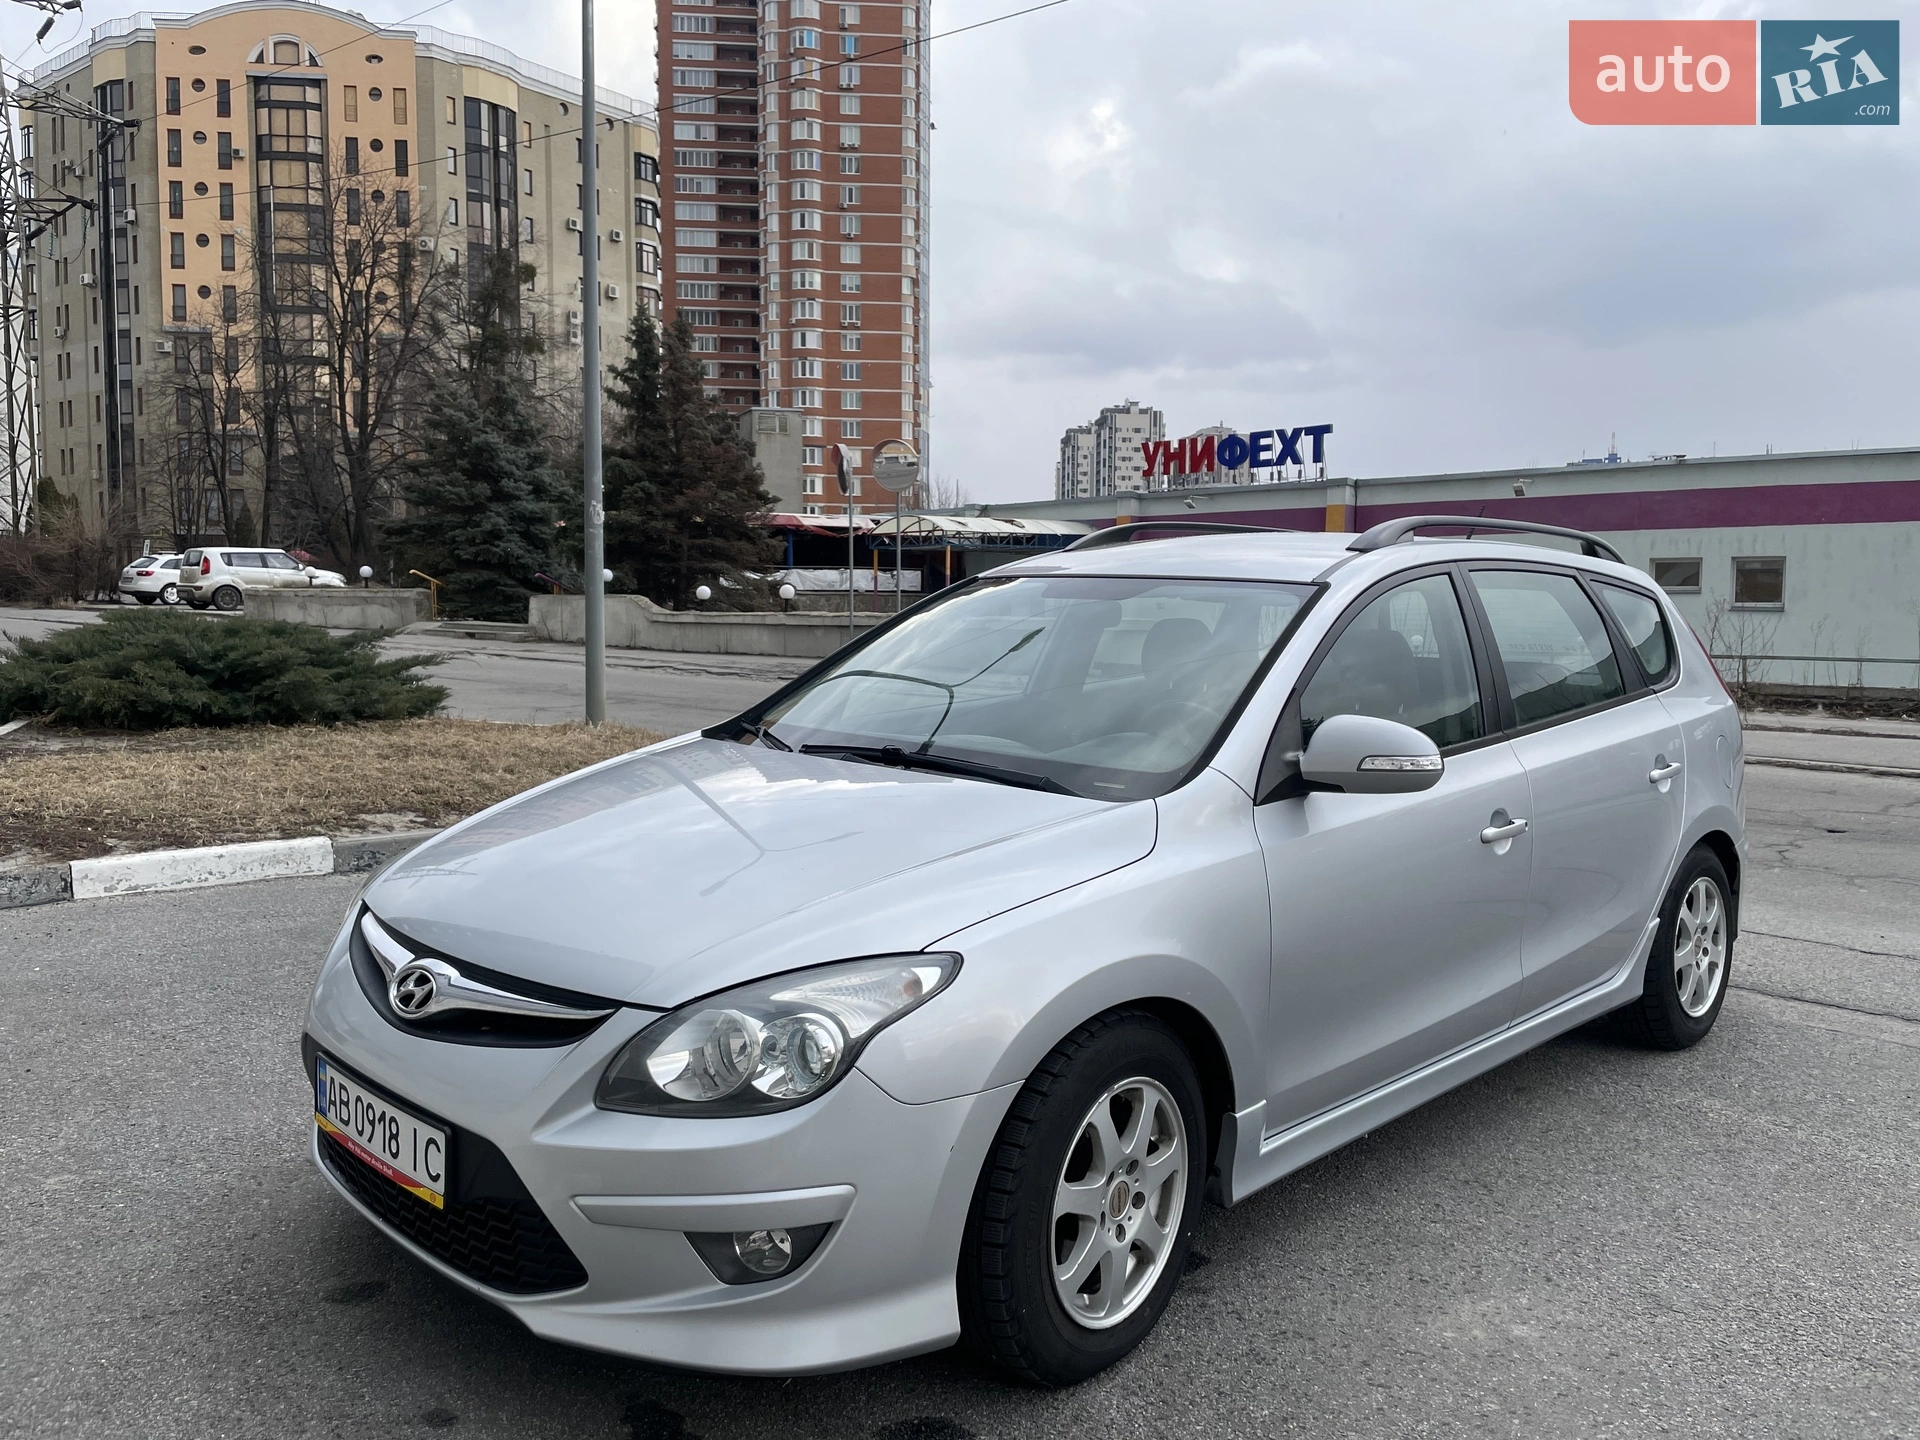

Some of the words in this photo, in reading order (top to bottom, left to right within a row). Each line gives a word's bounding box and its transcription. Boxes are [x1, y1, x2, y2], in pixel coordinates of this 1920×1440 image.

[1141, 424, 1333, 477] УНИФЕХТ
[328, 1076, 350, 1127] AB
[354, 1094, 400, 1160] 0918
[413, 1127, 441, 1183] IC
